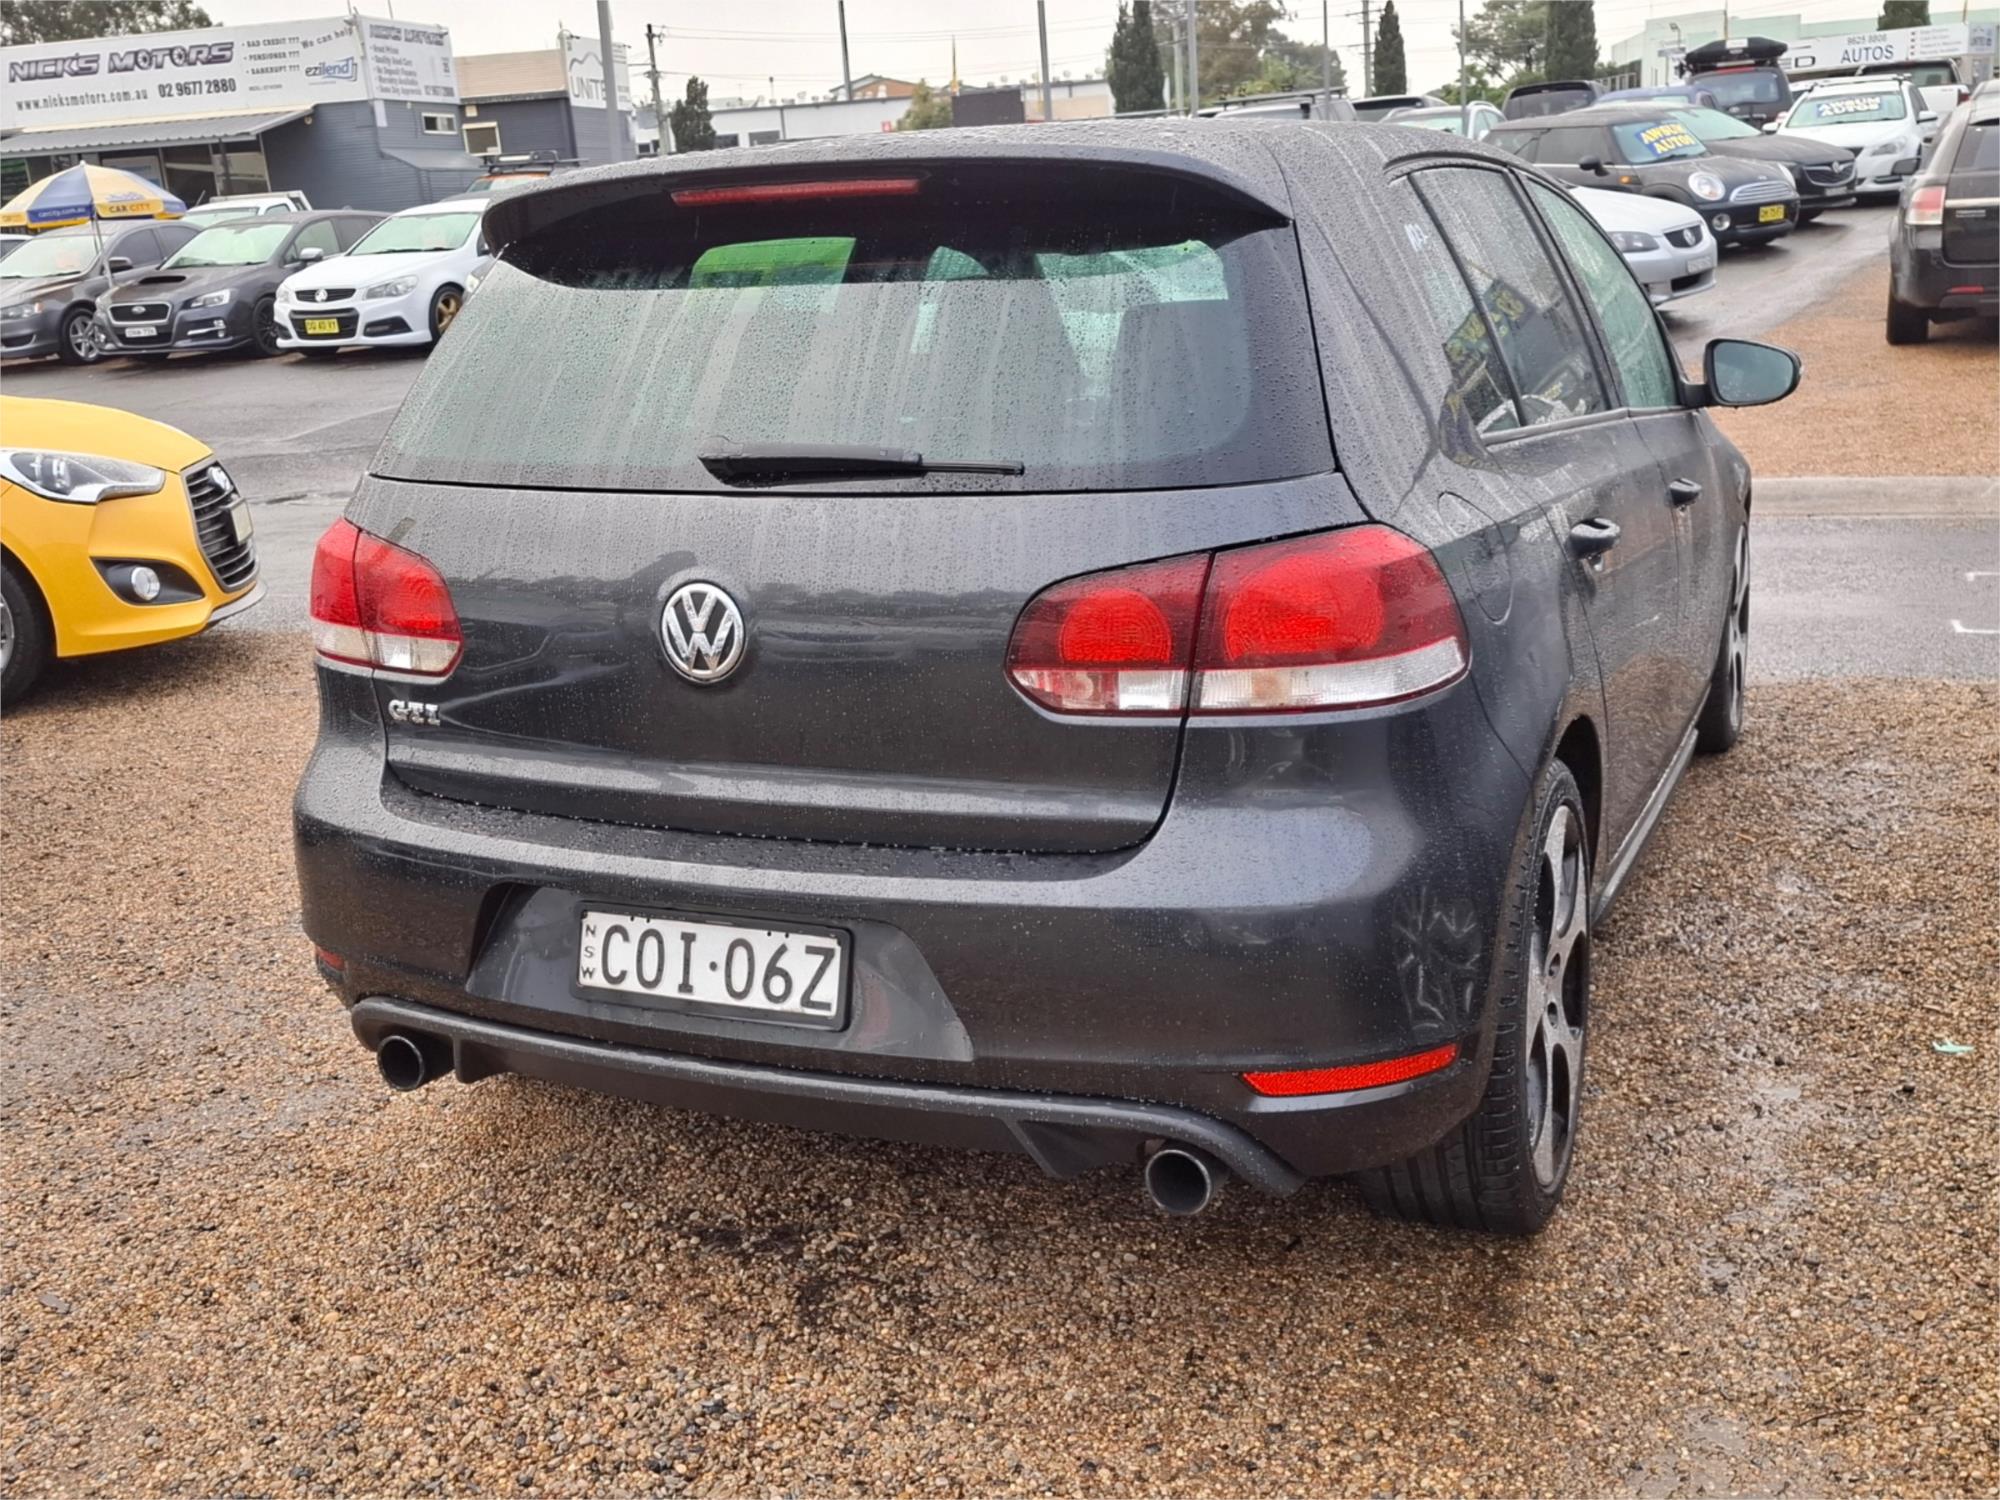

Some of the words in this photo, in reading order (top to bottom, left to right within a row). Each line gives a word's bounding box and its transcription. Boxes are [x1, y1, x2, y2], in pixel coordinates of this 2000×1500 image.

[301, 40, 314, 49] We
[316, 34, 332, 44] can
[107, 41, 235, 73] MOTORS
[1840, 44, 1894, 64] AUTOS
[158, 83, 174, 98] 02
[175, 80, 203, 97] 9677
[205, 77, 237, 94] 2880
[109, 205, 128, 213] CAR
[130, 203, 151, 213] CITY
[387, 699, 441, 726] GTI
